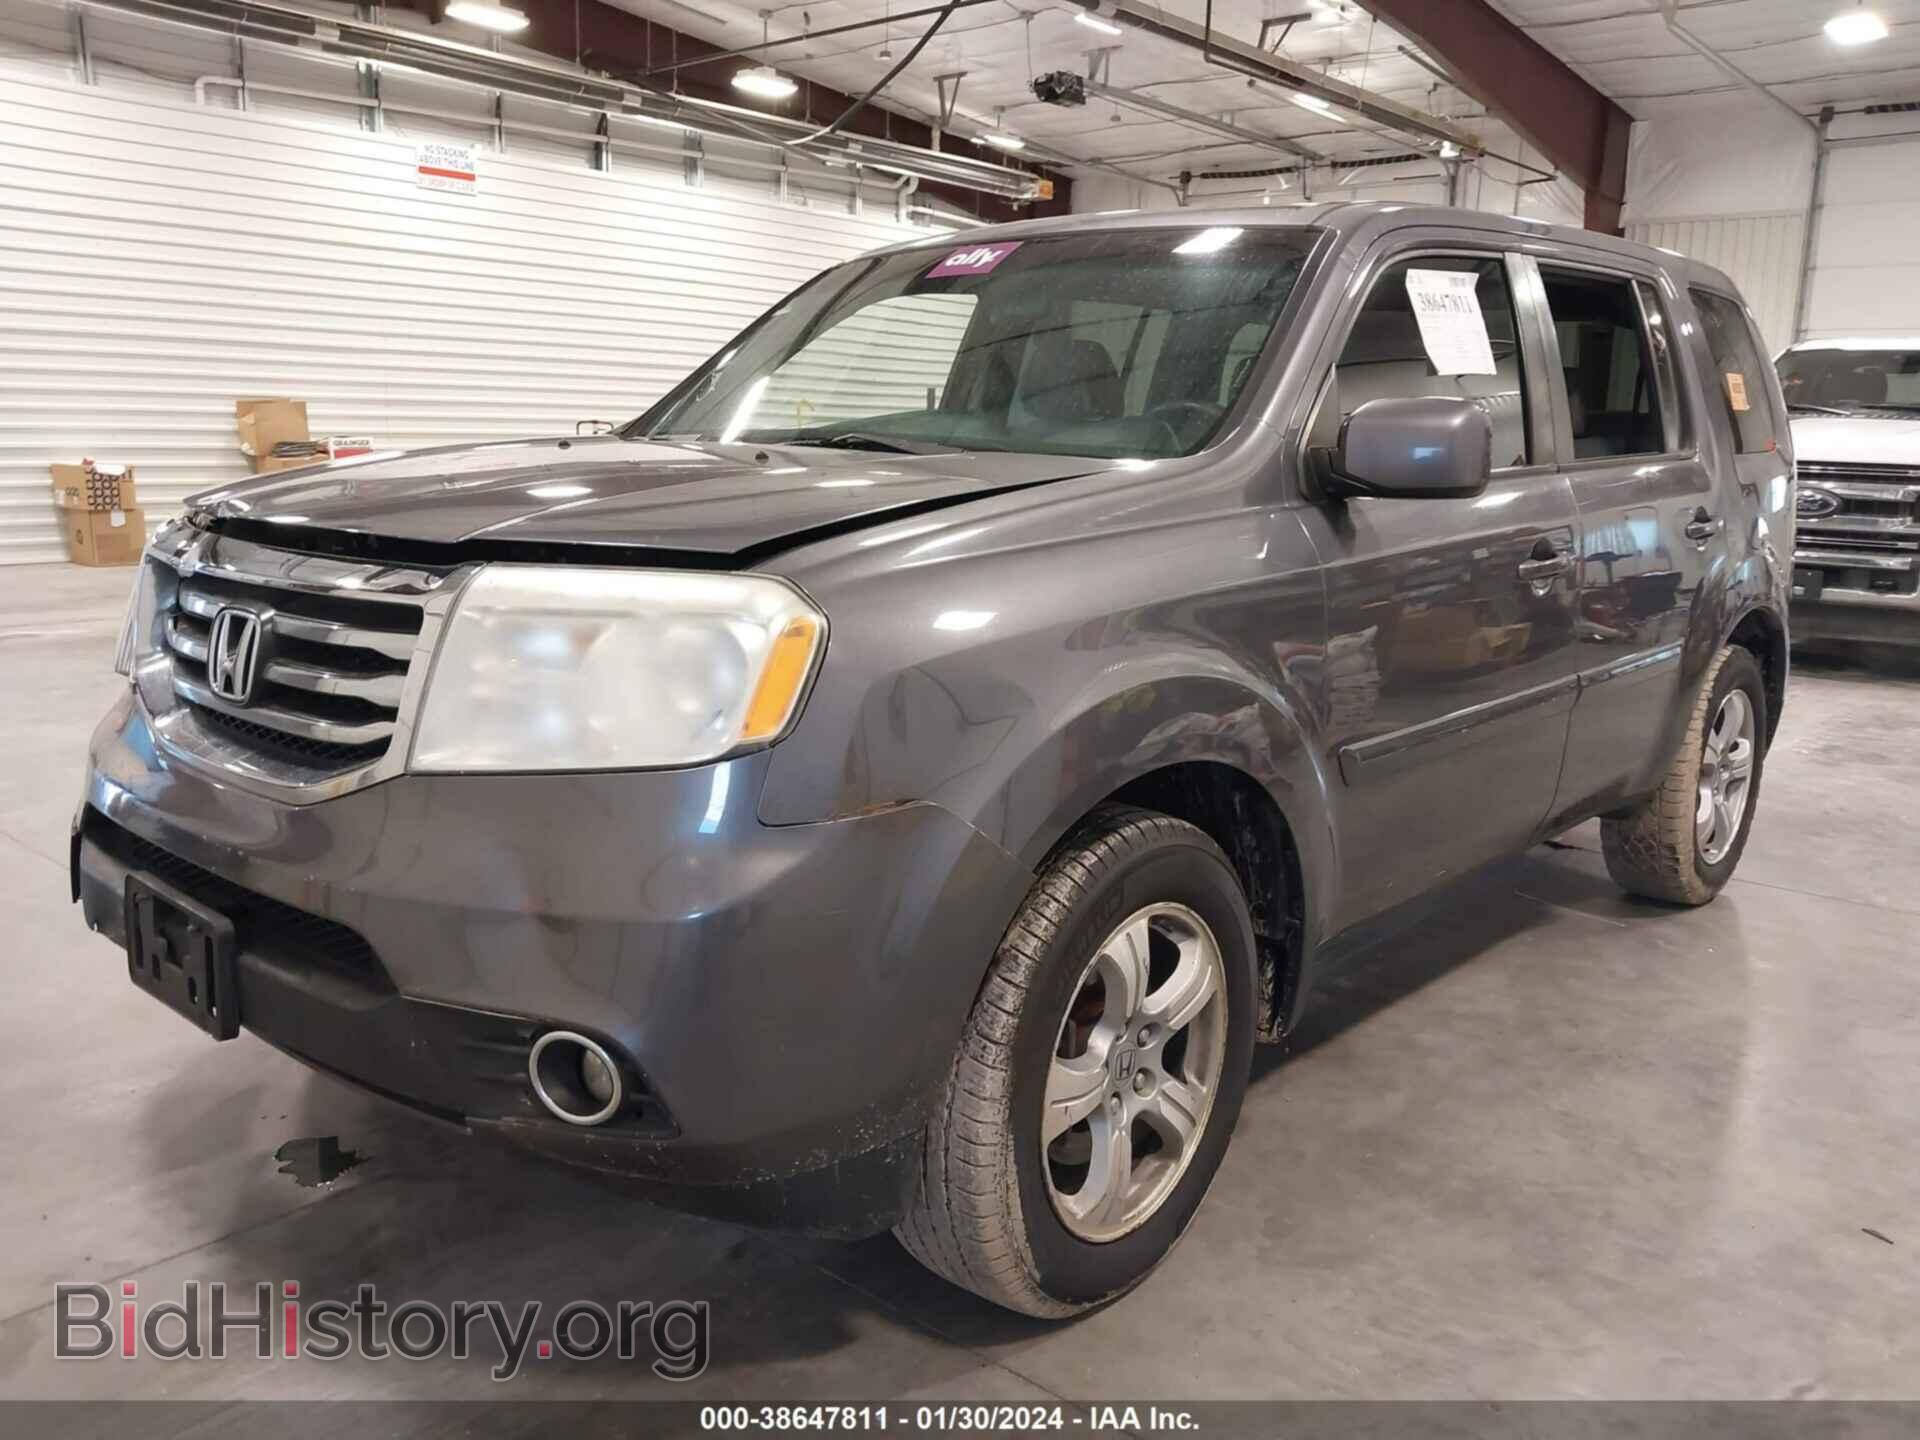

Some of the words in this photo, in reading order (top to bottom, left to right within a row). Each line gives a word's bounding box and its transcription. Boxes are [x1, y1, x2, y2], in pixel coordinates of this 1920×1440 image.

[419, 154, 441, 166] ABOVE
[443, 158, 458, 169] THIS
[436, 145, 469, 160] STACKING
[944, 247, 1004, 268] ally
[1417, 293, 1474, 314] 38647811
